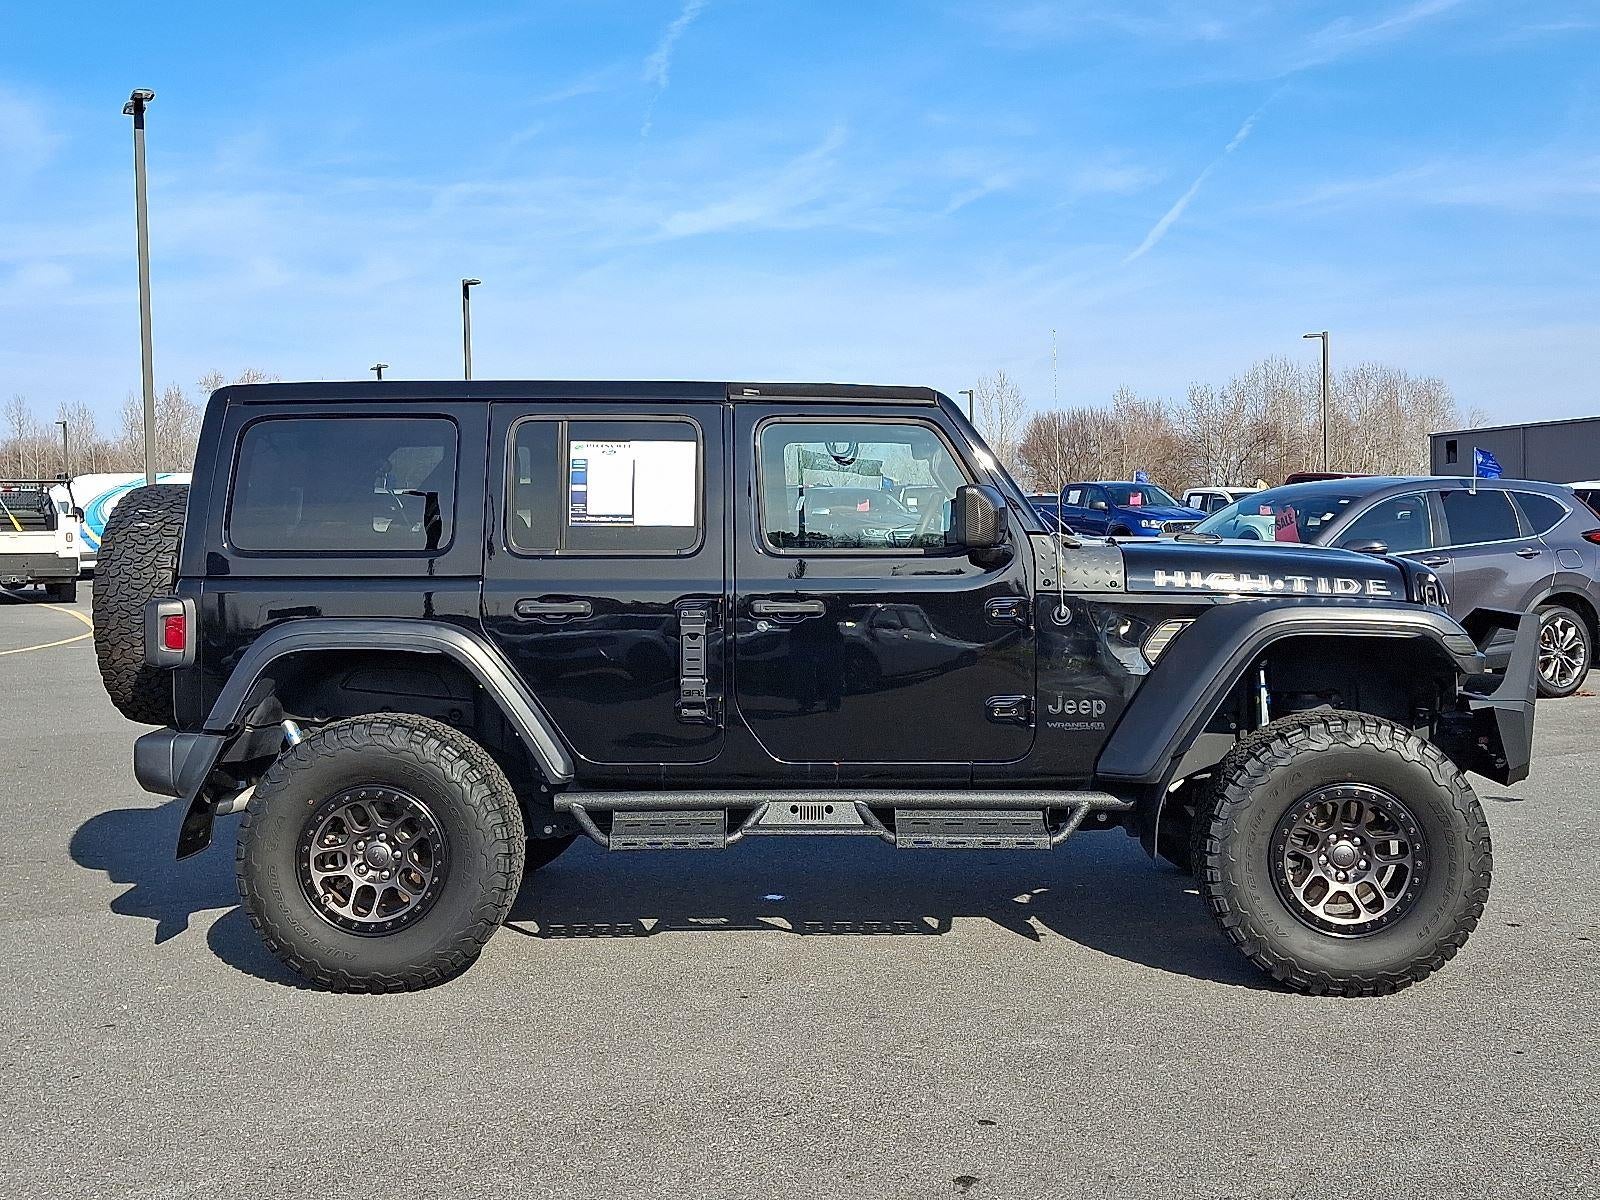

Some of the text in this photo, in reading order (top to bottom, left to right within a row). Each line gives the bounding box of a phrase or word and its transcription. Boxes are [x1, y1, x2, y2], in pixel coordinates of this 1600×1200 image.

[1276, 513, 1295, 531] SALE
[1047, 696, 1107, 718] Jeep
[1046, 721, 1105, 729] WRANGLER
